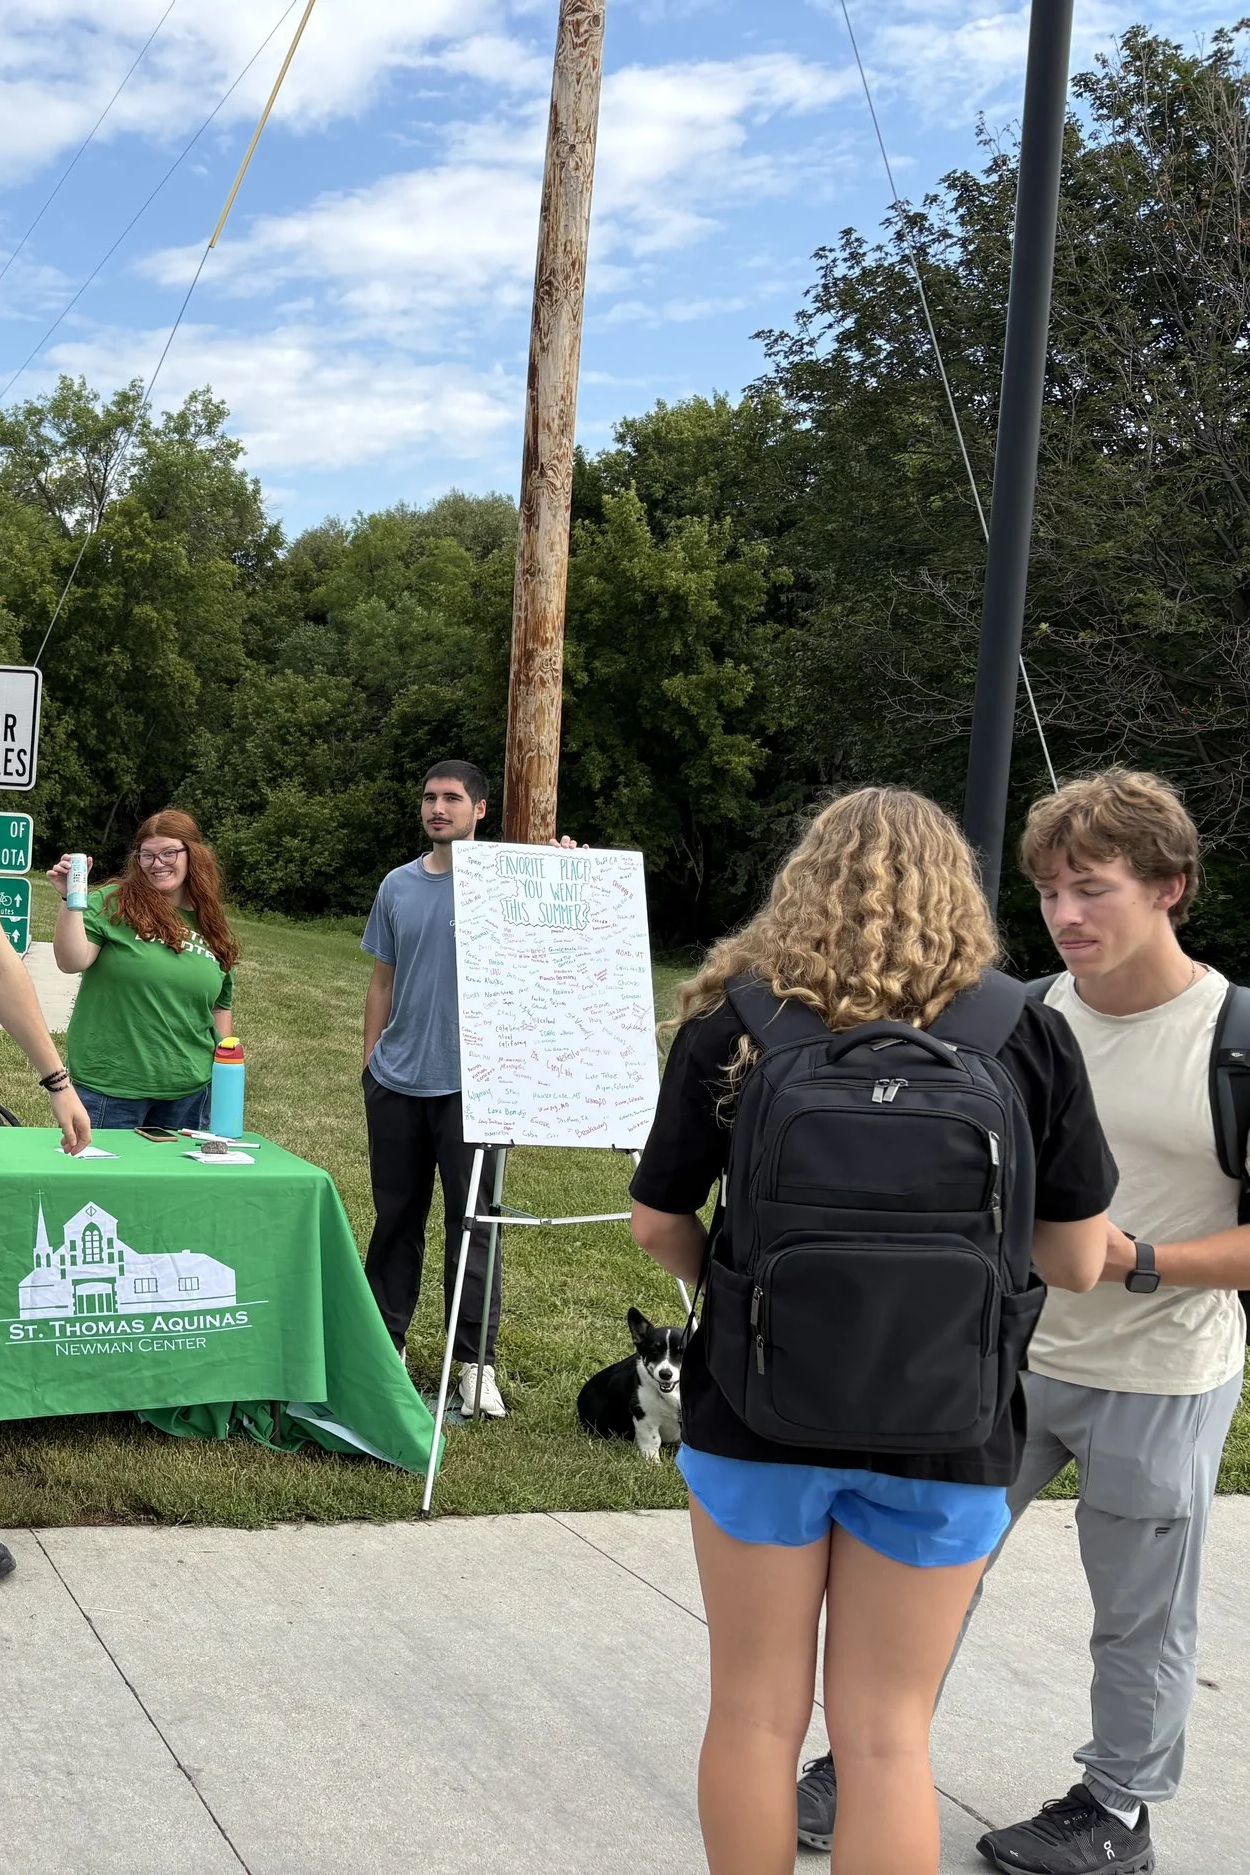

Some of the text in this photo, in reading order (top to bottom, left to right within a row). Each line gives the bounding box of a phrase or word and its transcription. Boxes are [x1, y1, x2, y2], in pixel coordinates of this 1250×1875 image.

[10, 821, 27, 838] OF
[499, 855, 546, 879] FAVORITE
[560, 858, 588, 882] PLACE
[519, 878, 543, 898] YOU
[550, 882, 579, 902] WENT
[503, 898, 530, 922] THIS
[8, 1311, 249, 1341] ST. THOMAS AQUINAS
[55, 1337, 207, 1357] NEWMAN CENTER
